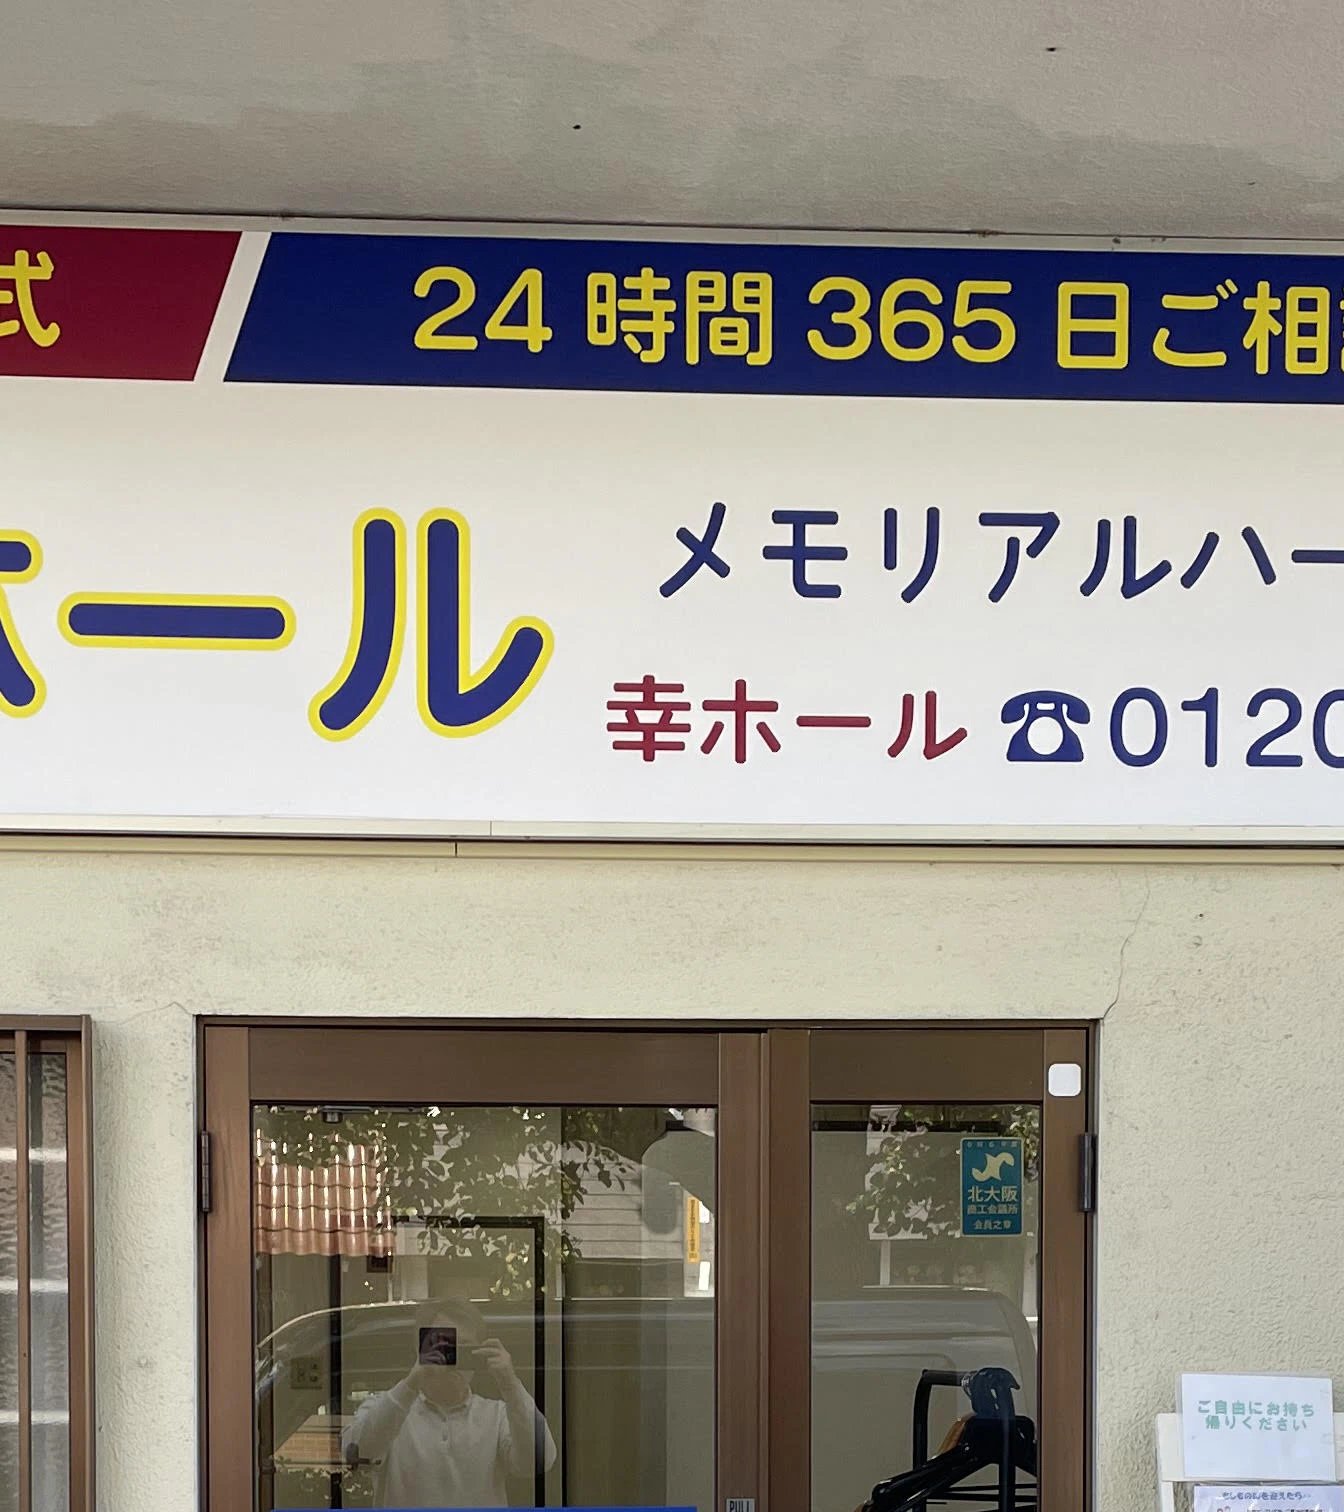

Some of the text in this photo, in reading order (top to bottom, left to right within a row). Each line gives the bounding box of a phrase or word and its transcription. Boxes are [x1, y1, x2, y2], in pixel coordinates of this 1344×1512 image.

[413, 266, 553, 354] 24
[587, 268, 774, 368] 時間
[807, 277, 1017, 365] 365
[606, 675, 970, 766] 幸ホール
[967, 1185, 1019, 1203] 北大阪
[1197, 1400, 1316, 1418] ご自由にお持ち
[1205, 1415, 1308, 1432] 帰りください
